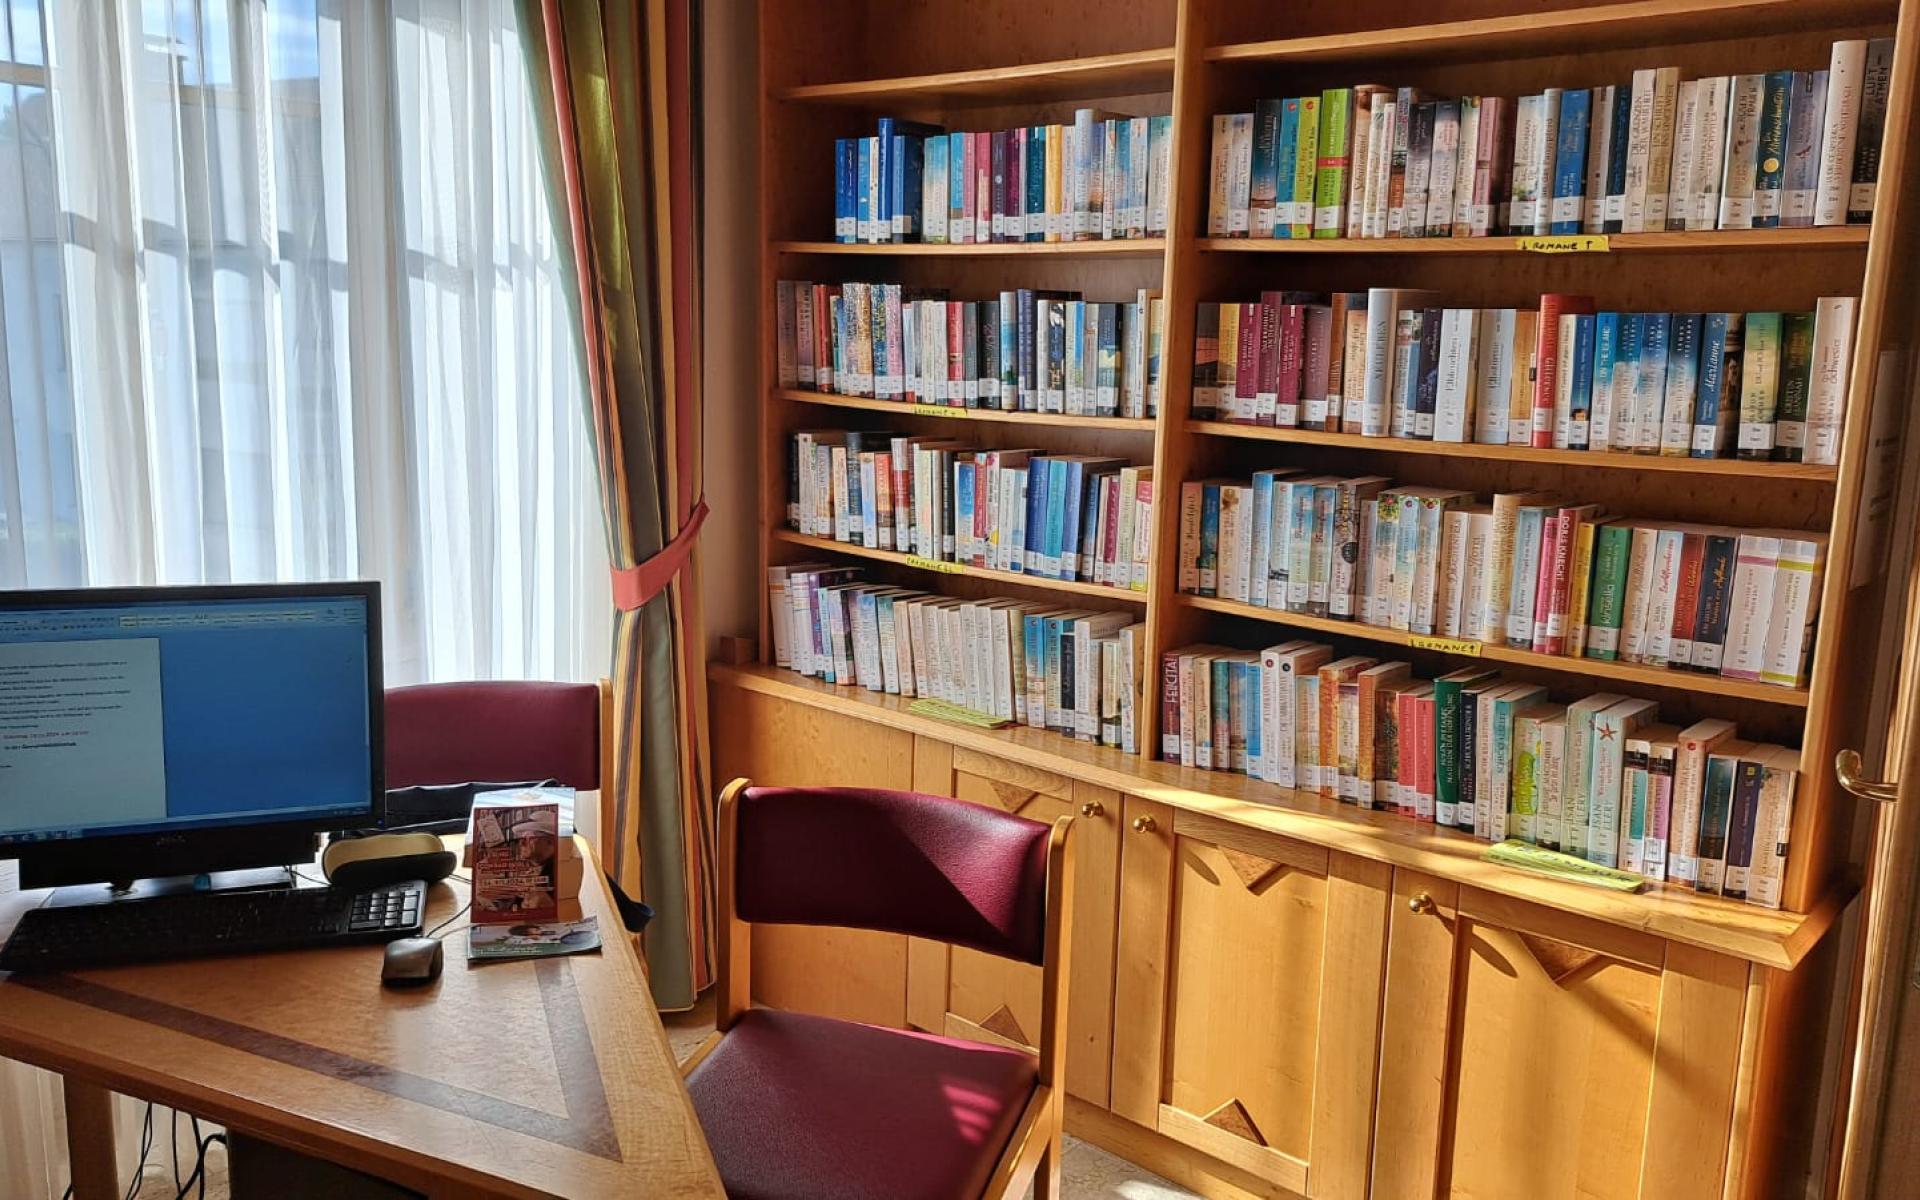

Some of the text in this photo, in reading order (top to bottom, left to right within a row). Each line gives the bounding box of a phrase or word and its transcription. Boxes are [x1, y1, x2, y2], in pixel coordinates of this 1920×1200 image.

[1877, 67, 1889, 105] ATMEN
[1556, 516, 1570, 581] DORIS KNECHT
